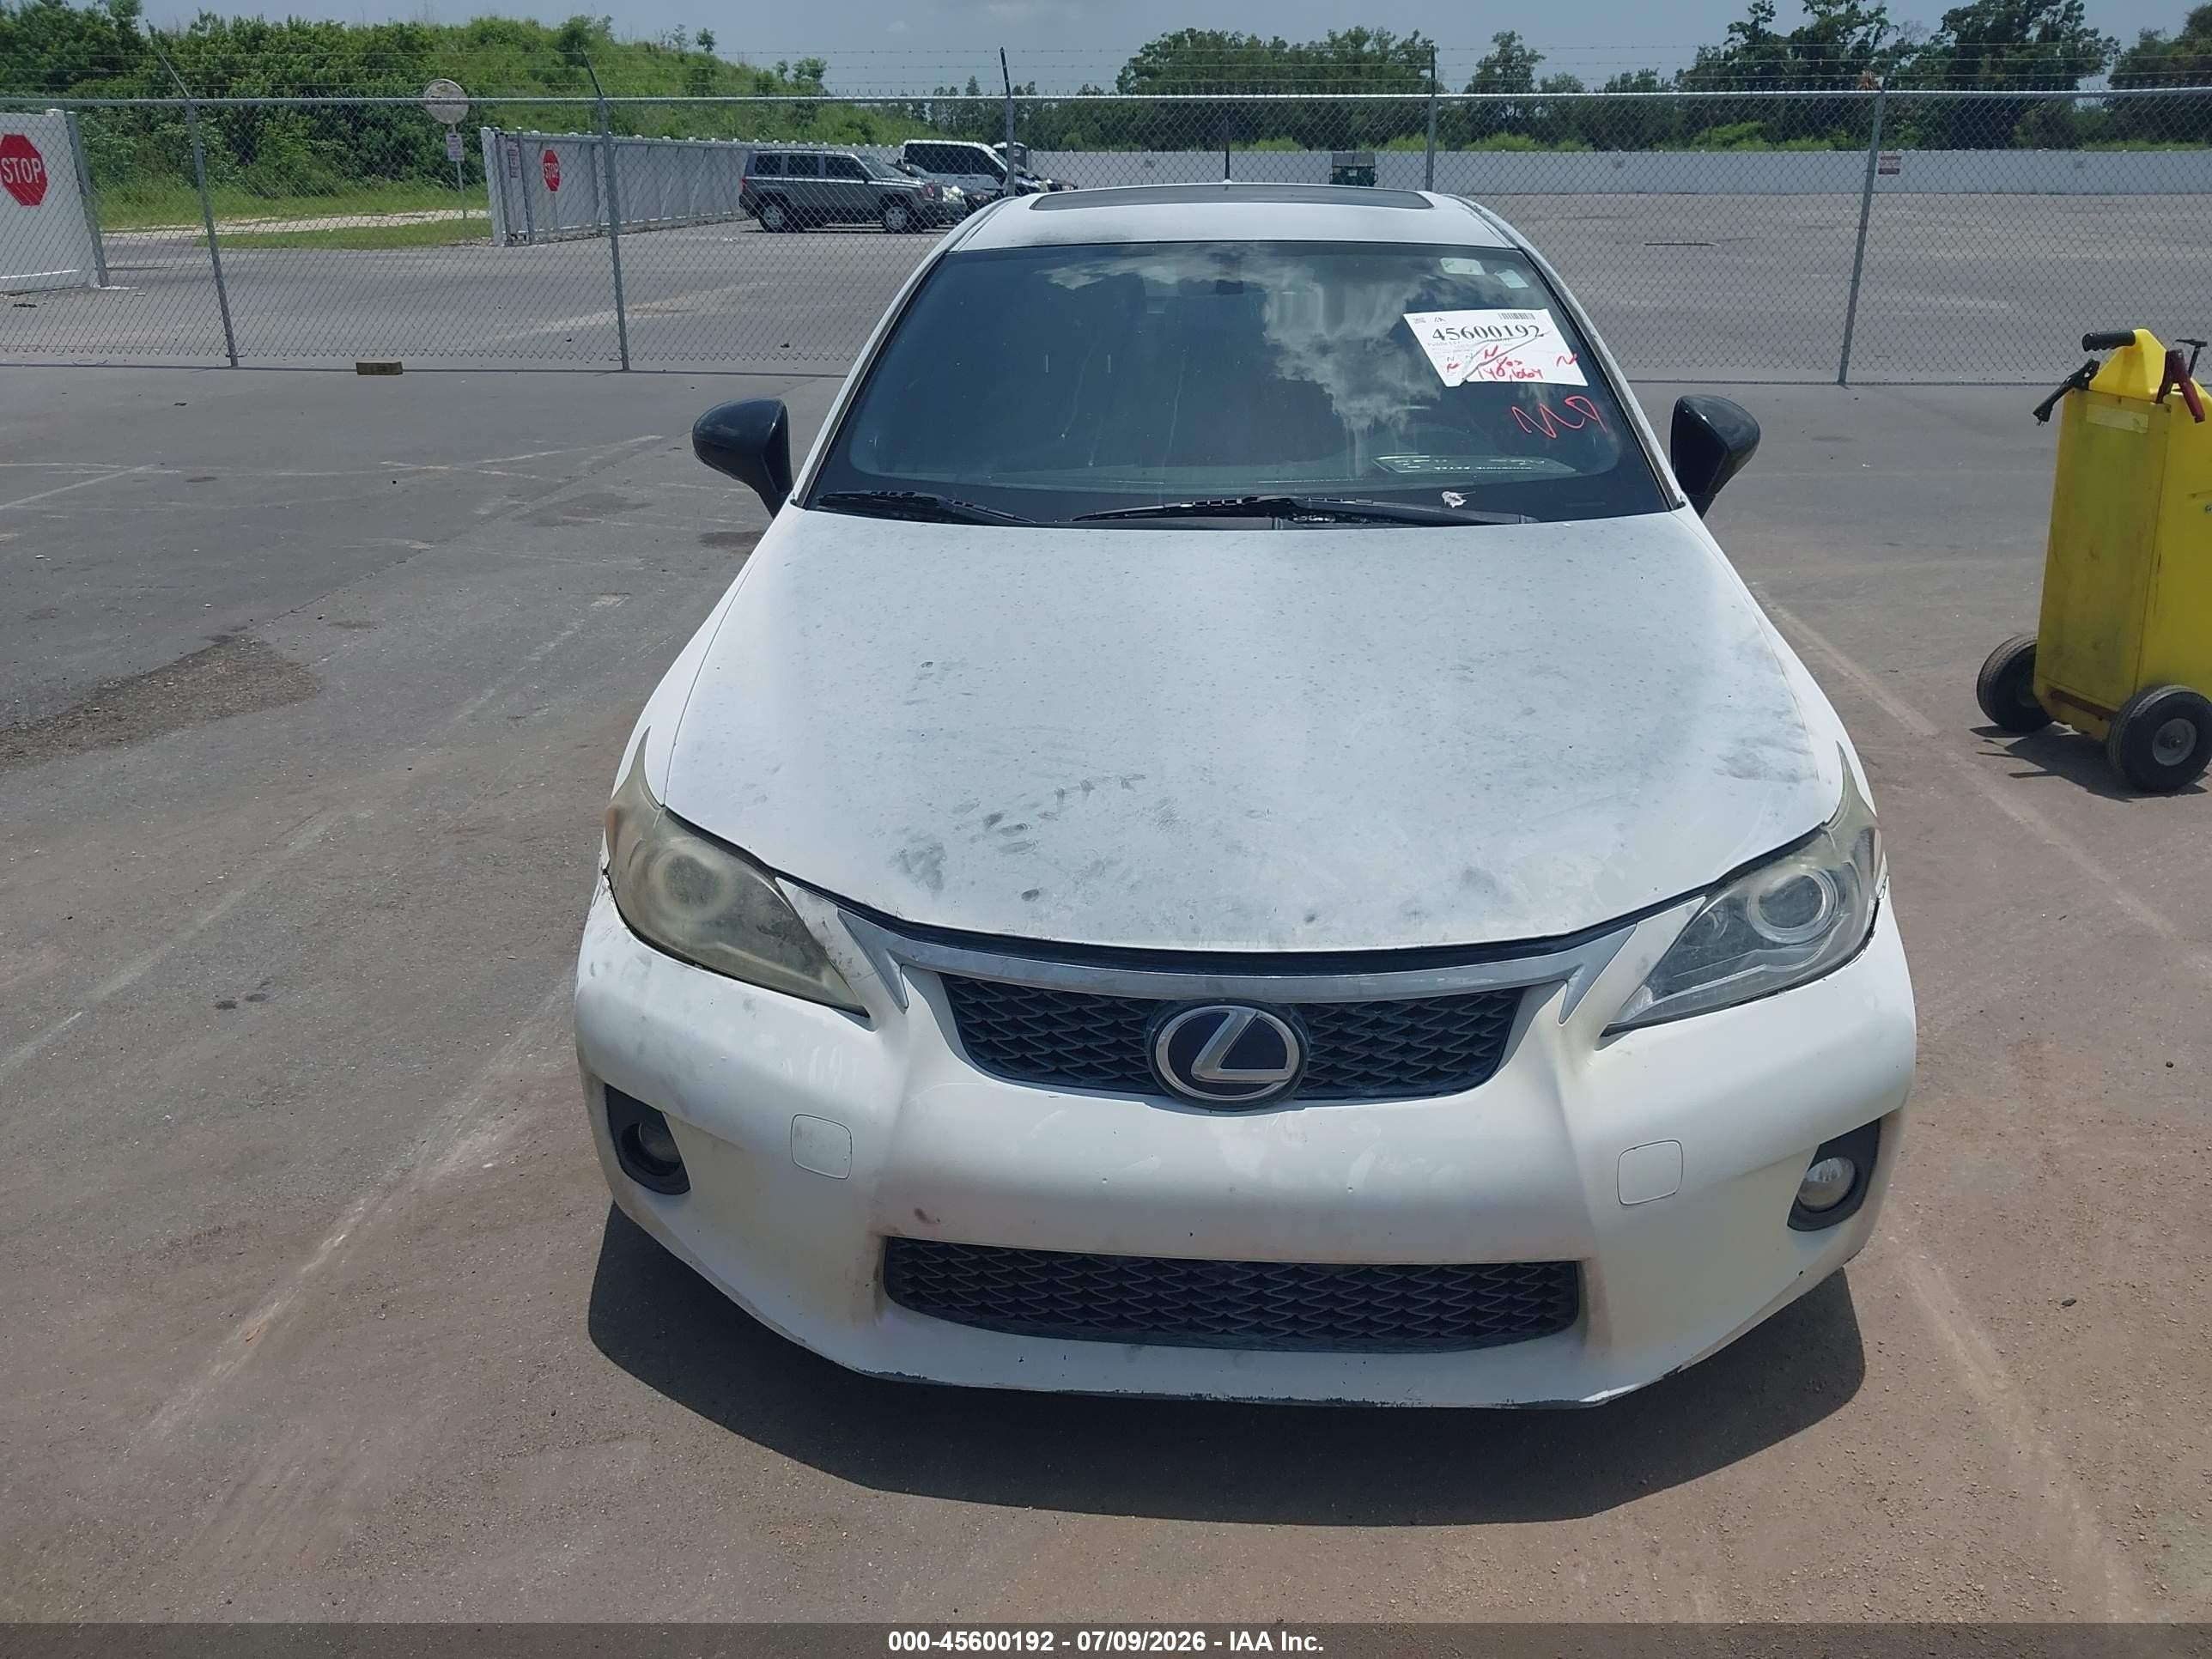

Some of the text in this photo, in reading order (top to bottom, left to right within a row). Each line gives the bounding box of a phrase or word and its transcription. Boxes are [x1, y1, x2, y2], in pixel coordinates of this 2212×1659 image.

[1, 157, 42, 184] STOP
[544, 162, 560, 179] STOP
[1432, 325, 1545, 341] 45600192
